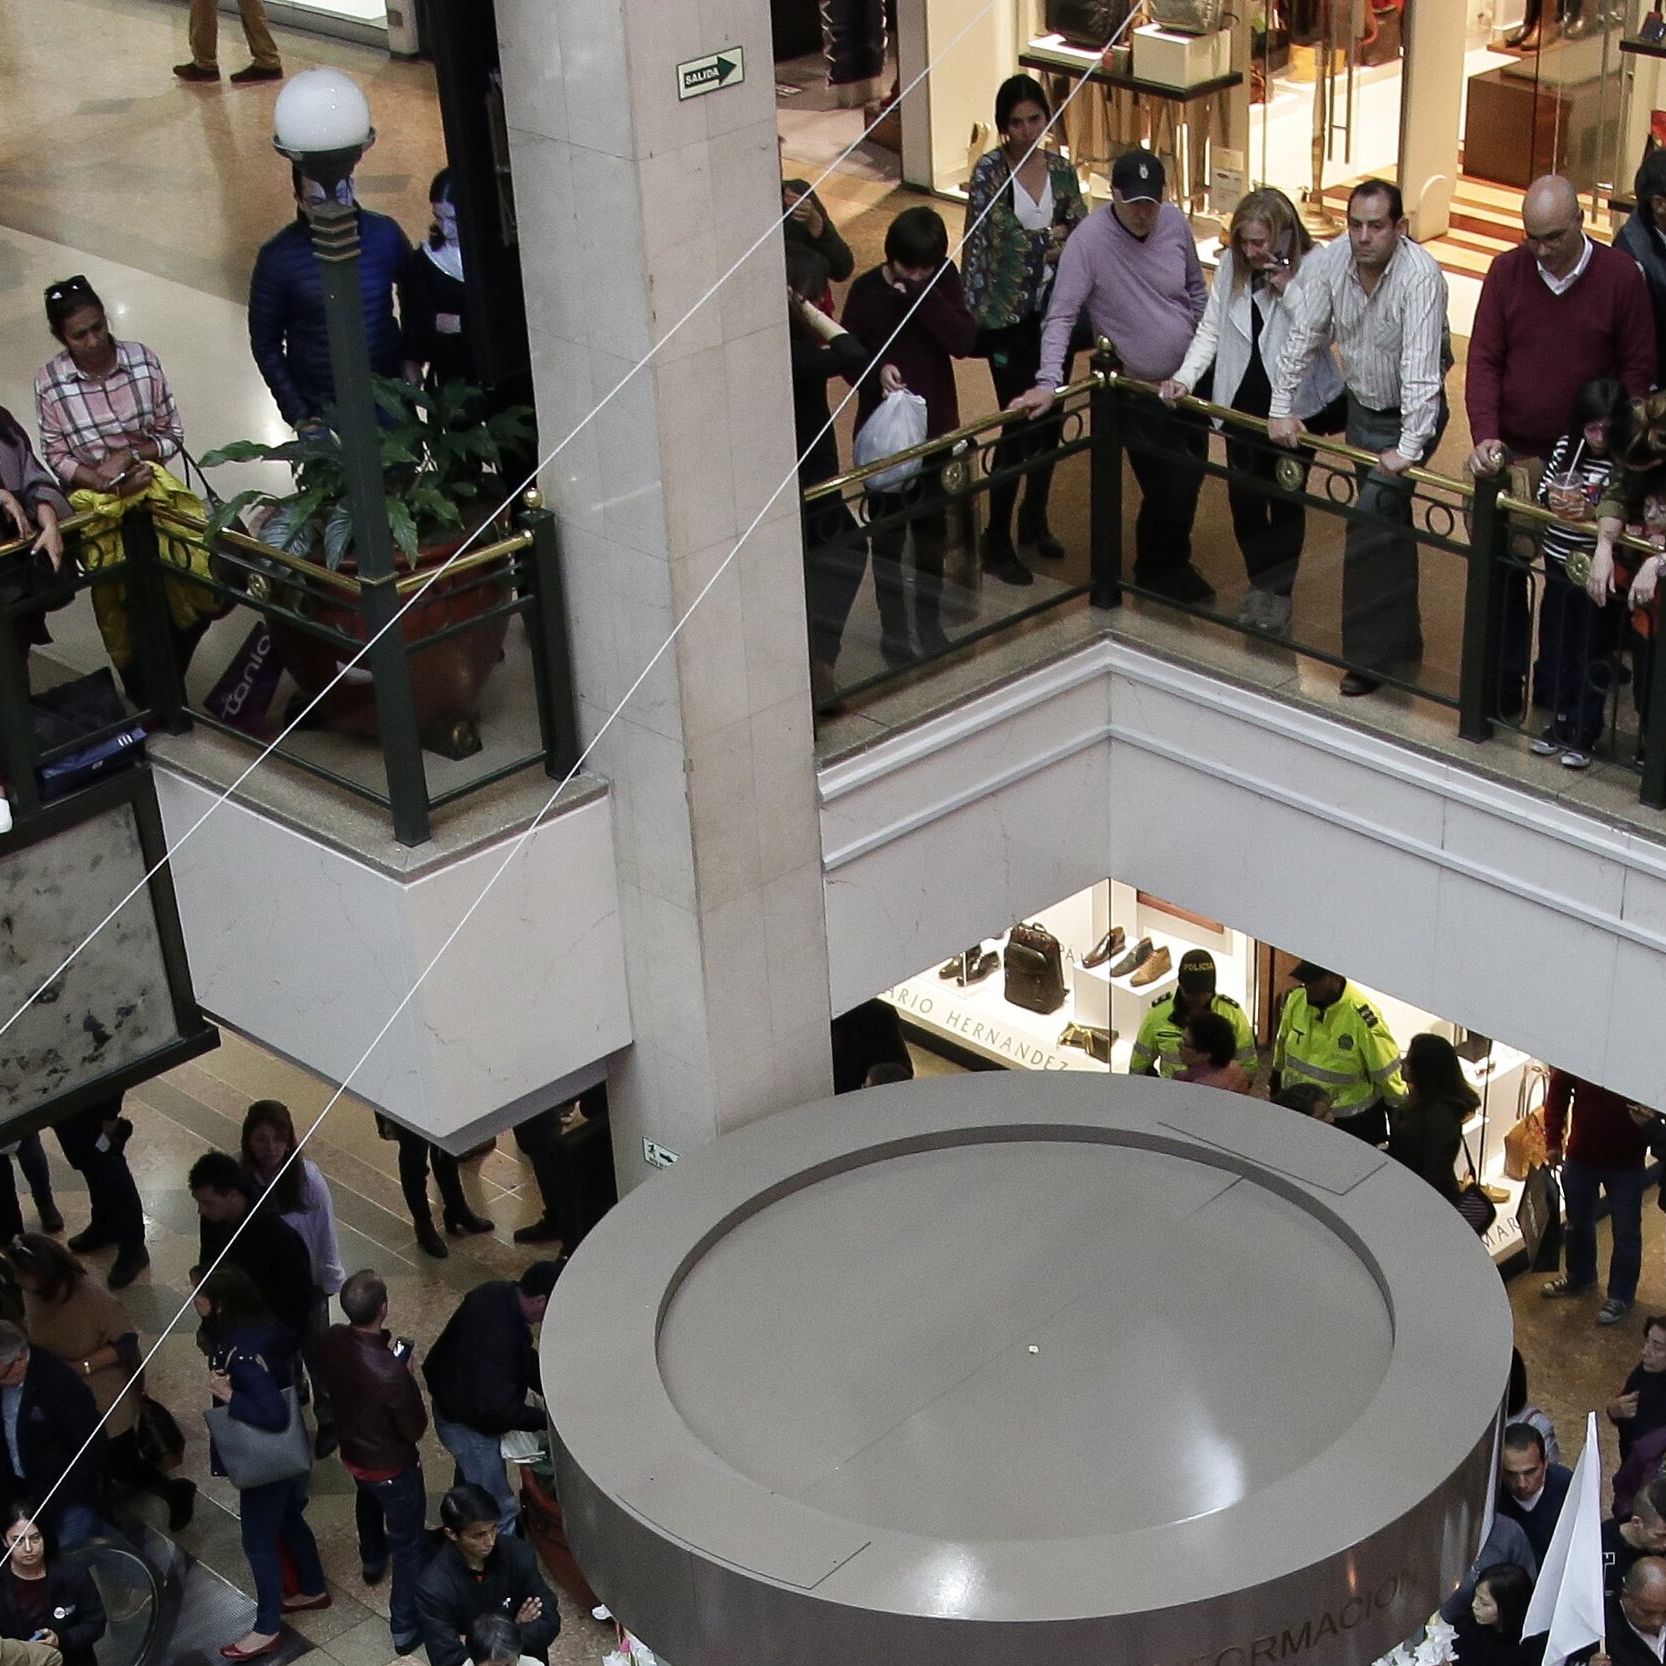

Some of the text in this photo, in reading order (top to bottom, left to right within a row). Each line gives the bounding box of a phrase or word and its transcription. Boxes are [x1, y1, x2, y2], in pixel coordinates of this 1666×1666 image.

[685, 67, 719, 86] SALIDA
[1183, 961, 1214, 971] POLICIA
[888, 987, 1070, 1070] ARIO HERNANDEZ
[1482, 1216, 1521, 1248] MAR
